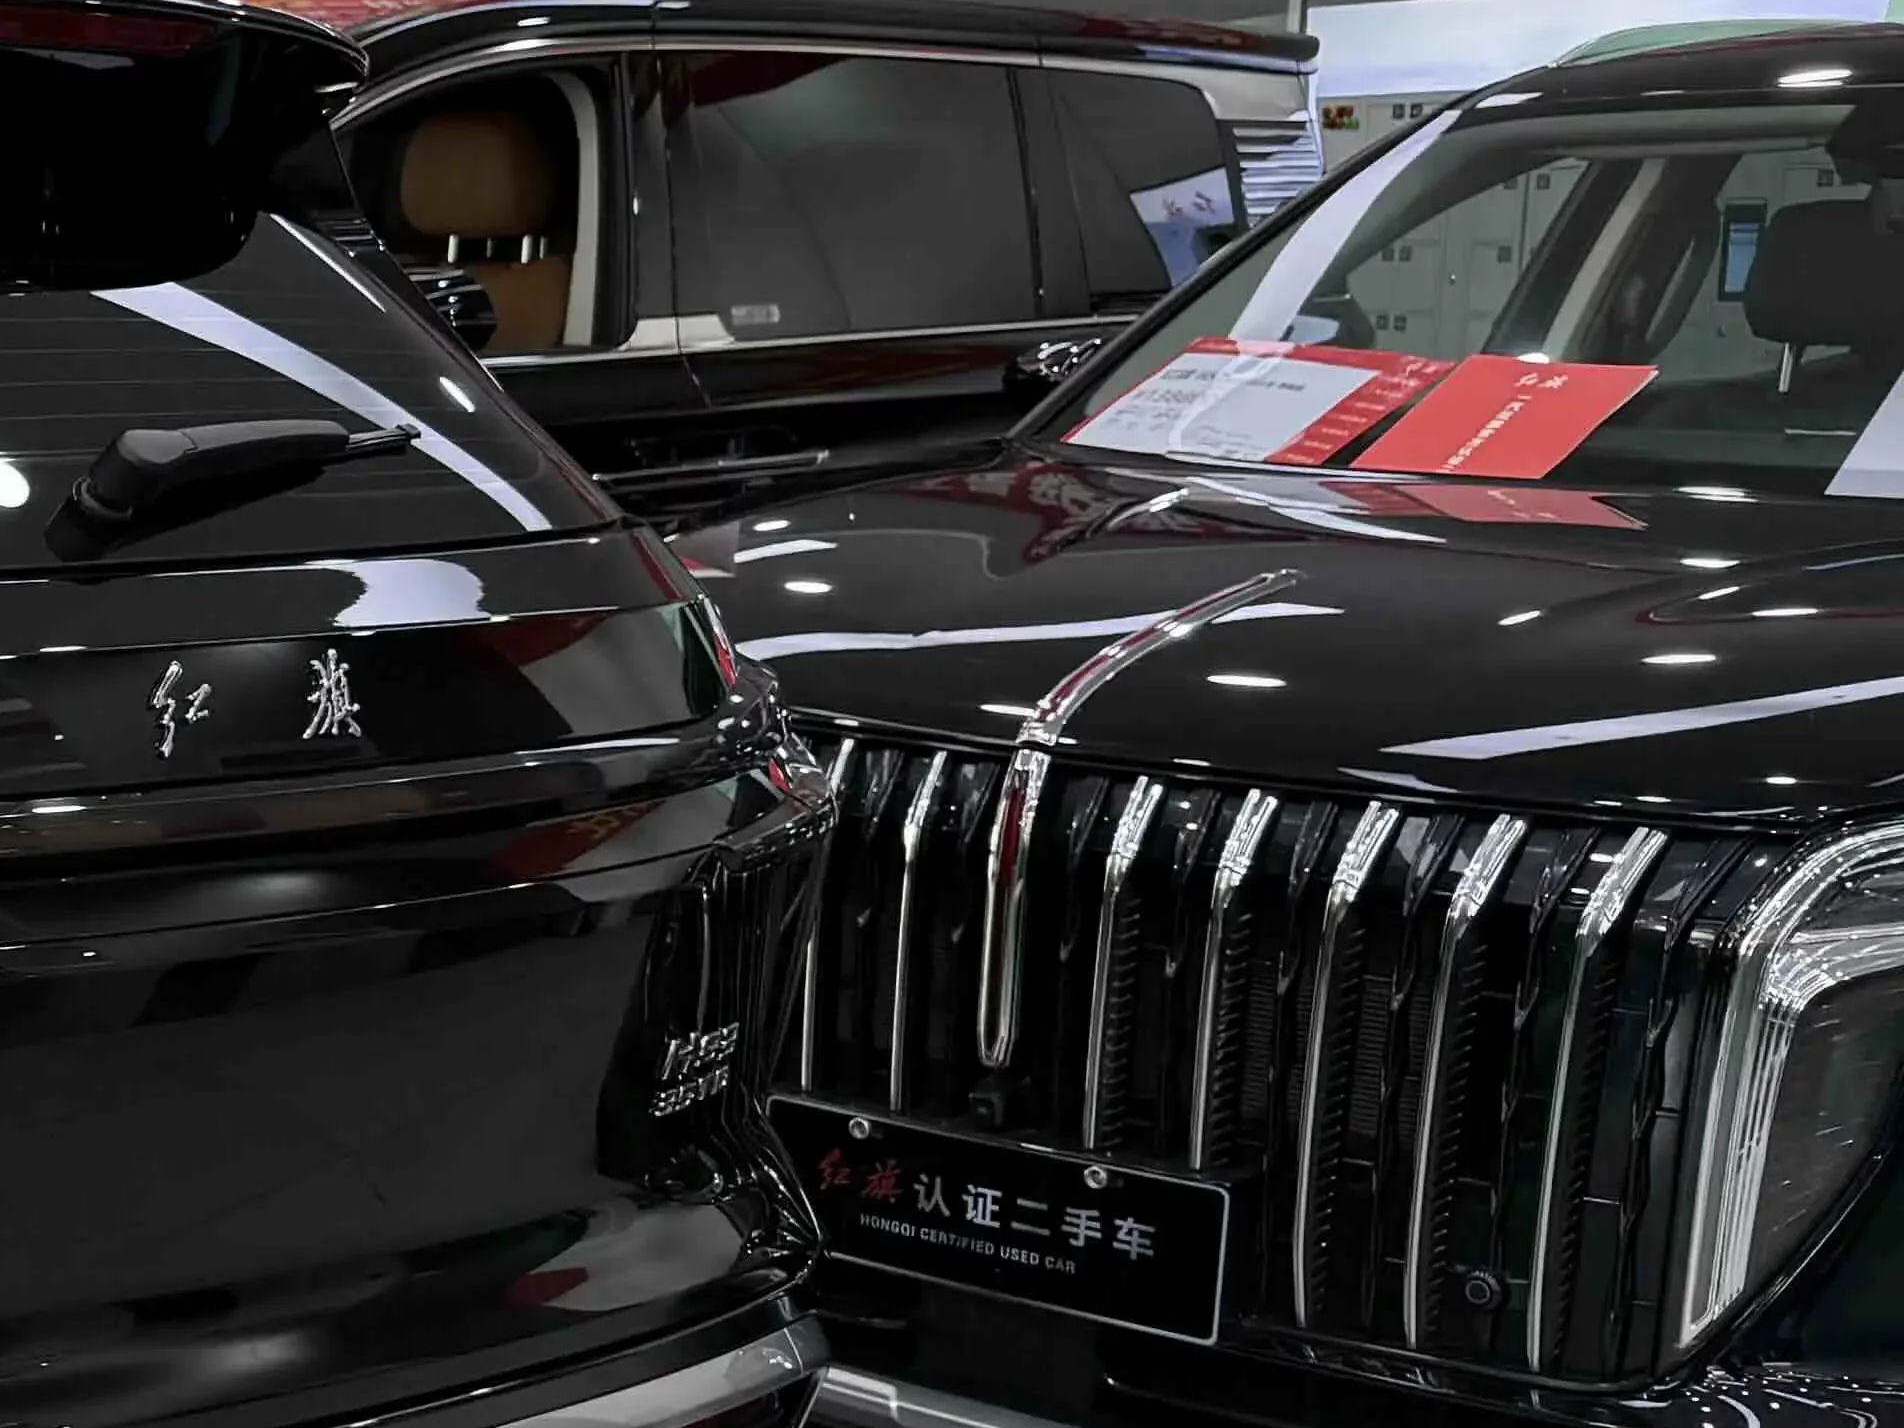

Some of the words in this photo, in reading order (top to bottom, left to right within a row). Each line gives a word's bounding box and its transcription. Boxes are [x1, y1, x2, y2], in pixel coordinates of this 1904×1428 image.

[148, 648, 362, 758] 红旗
[859, 1213, 916, 1238] HONGQI
[920, 1227, 995, 1256] CERTIFIED
[999, 1246, 1040, 1266] USED
[1044, 1256, 1076, 1275] CAR
